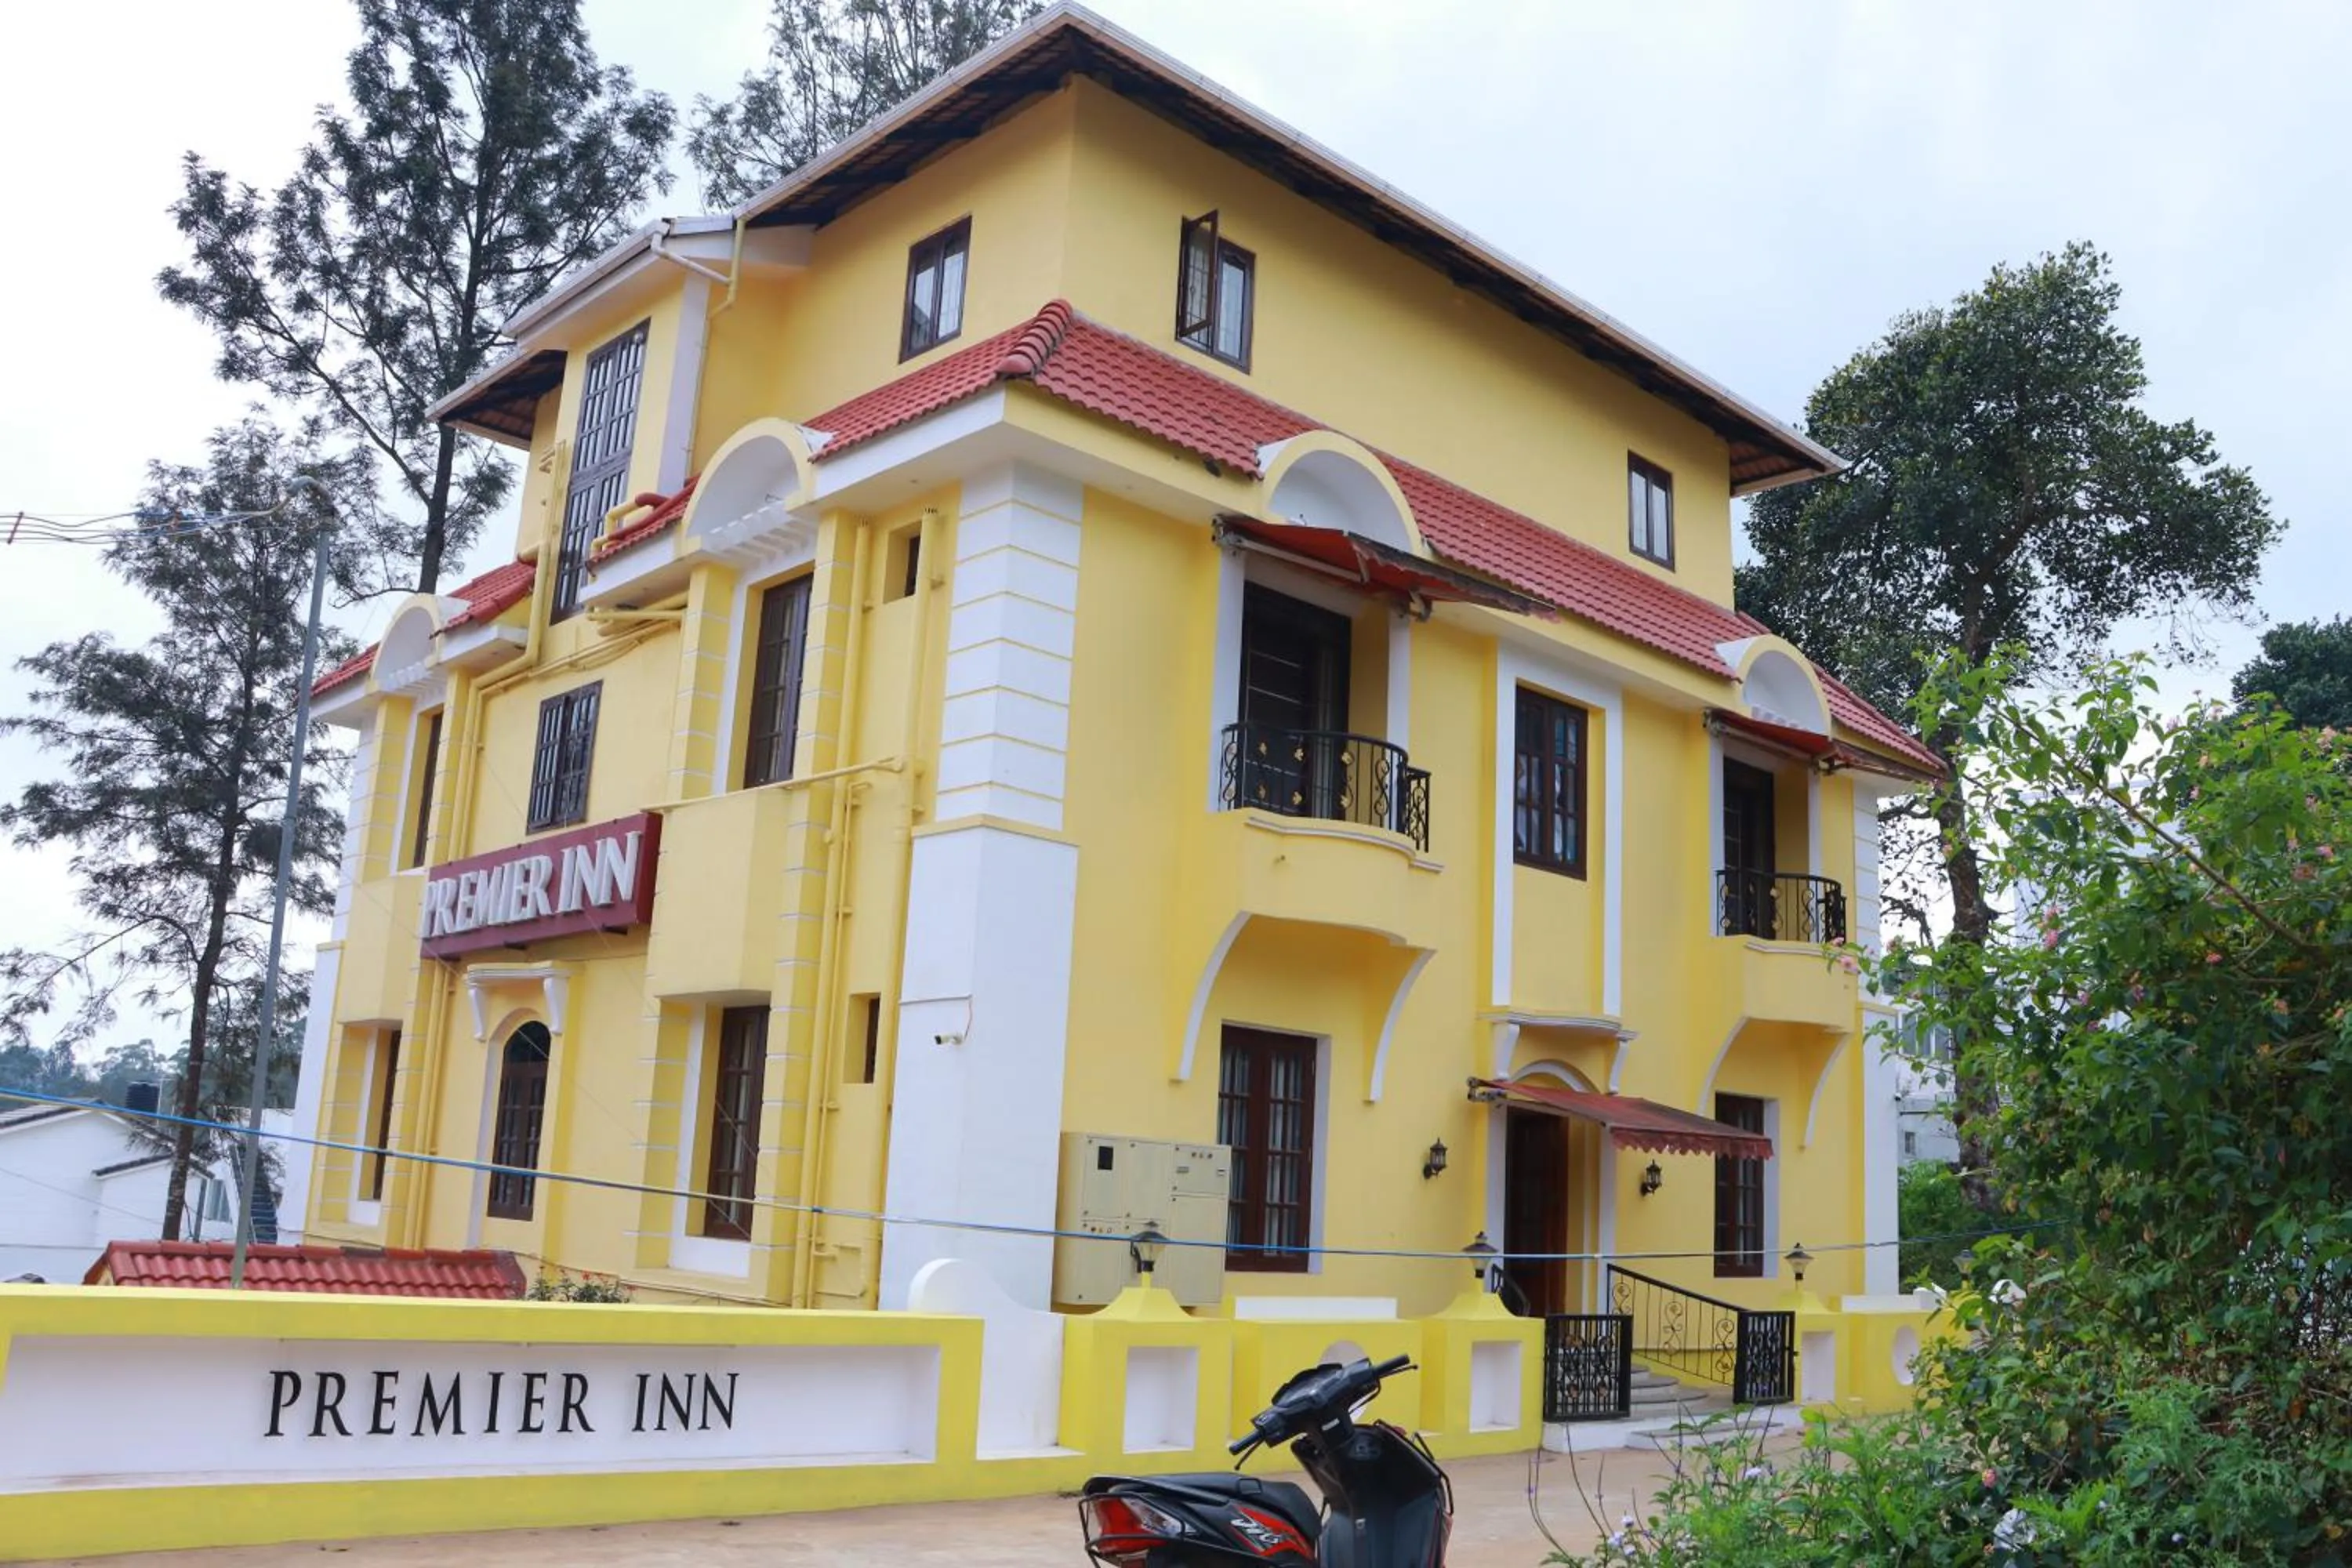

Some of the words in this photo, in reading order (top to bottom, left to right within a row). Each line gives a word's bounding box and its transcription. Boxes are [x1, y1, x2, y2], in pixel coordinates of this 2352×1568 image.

[421, 855, 553, 938] PREMIER
[555, 831, 642, 913] INN
[264, 1370, 594, 1437] PREMIER
[631, 1372, 739, 1432] INN
